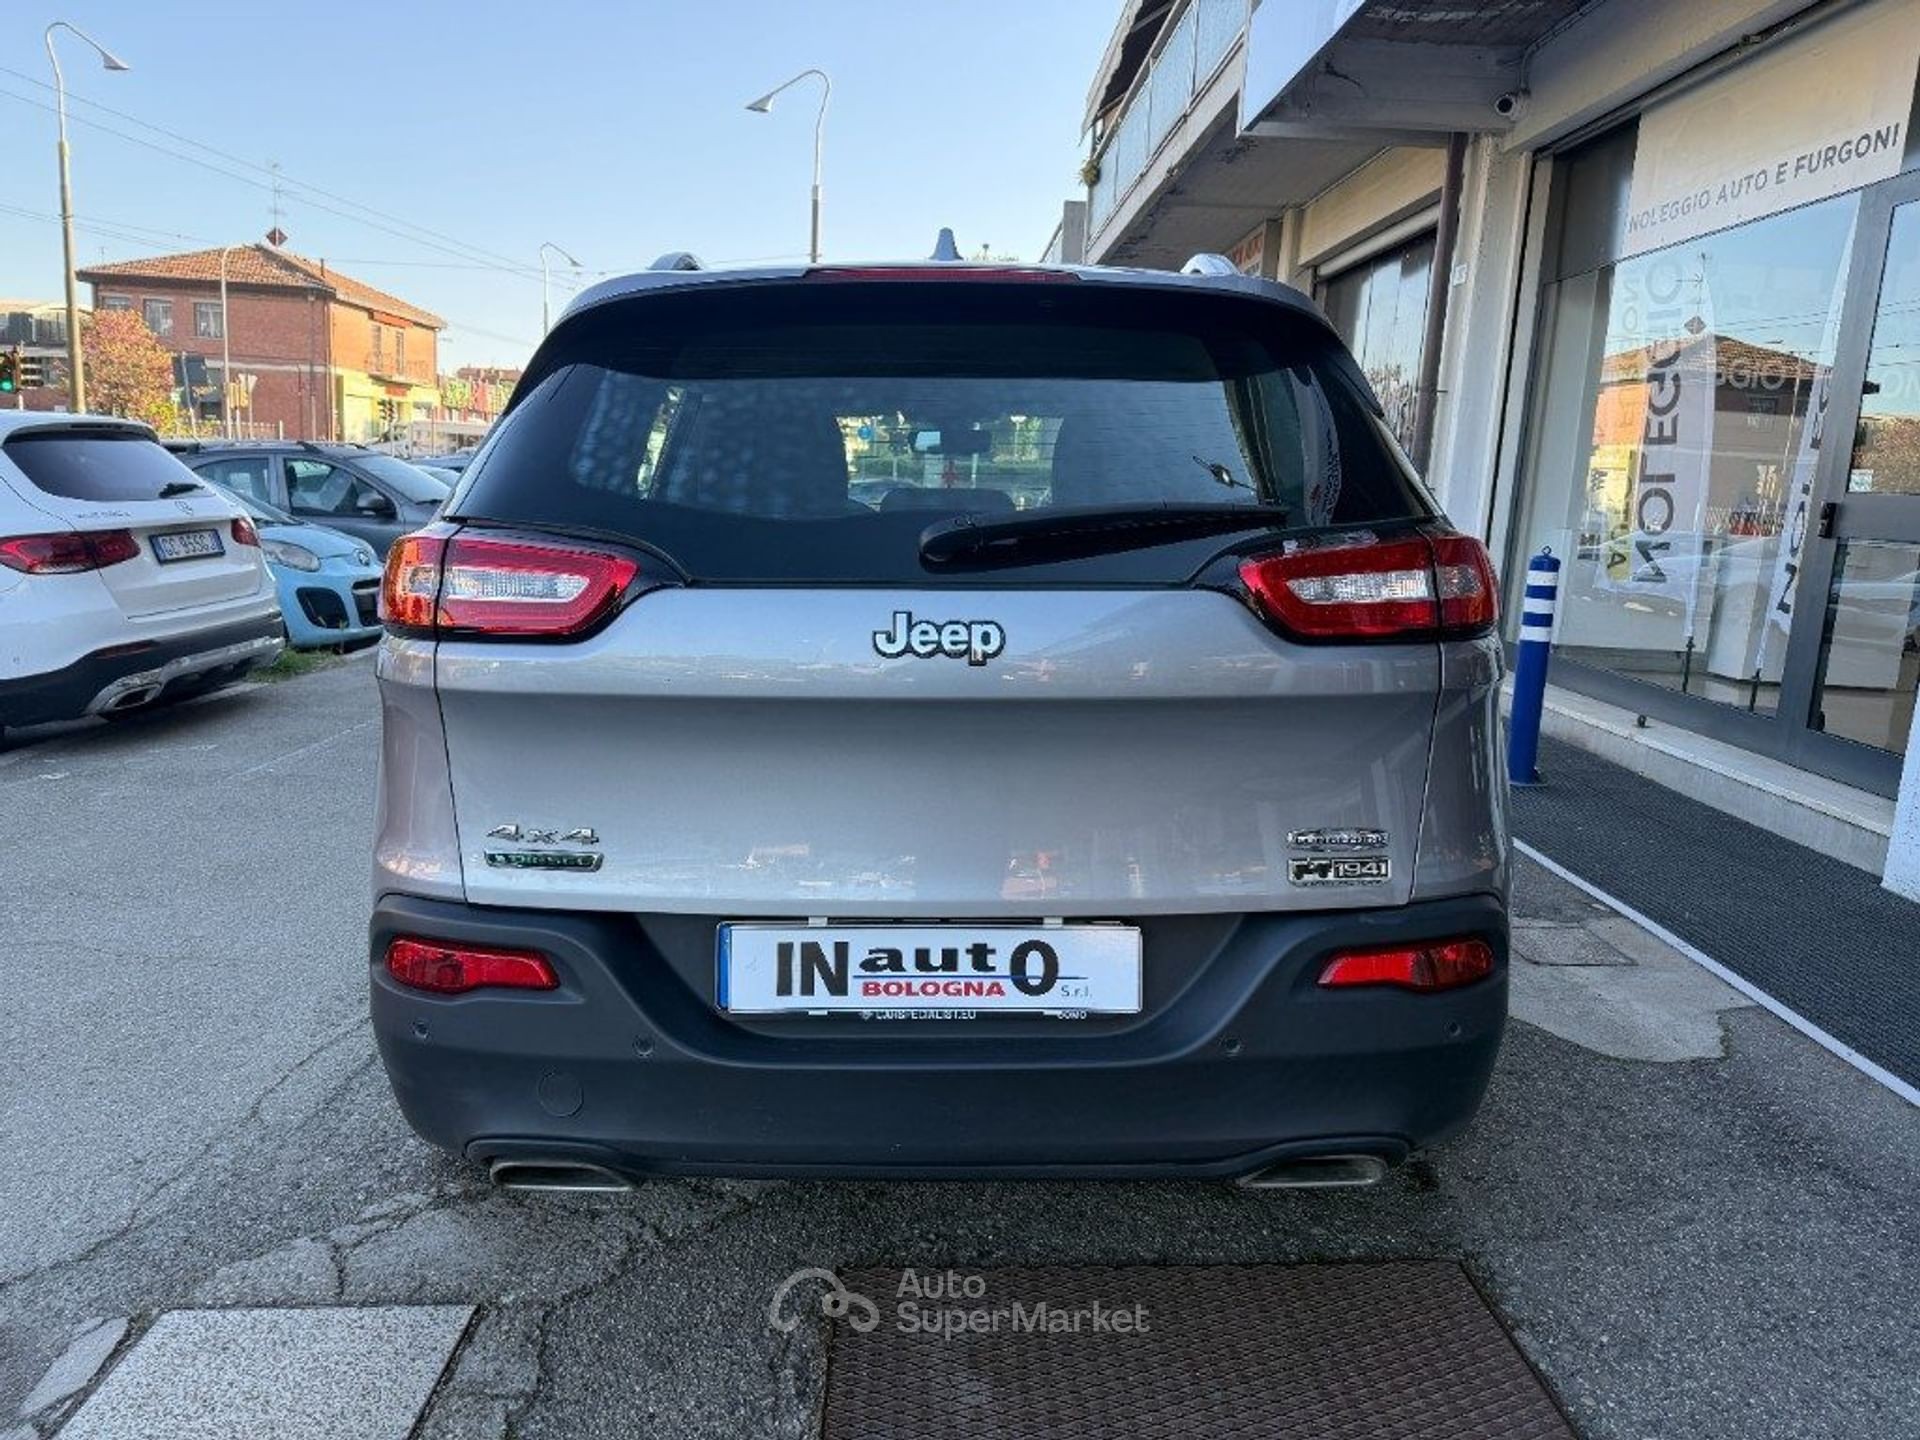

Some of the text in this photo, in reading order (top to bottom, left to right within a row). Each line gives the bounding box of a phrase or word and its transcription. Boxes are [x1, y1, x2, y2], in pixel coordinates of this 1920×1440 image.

[1627, 122, 1900, 233] NOLEGGIO AUTO E FURGONI
[872, 610, 1006, 667] Jeep
[487, 823, 600, 846] 4x4
[1334, 861, 1388, 879] 1941
[862, 981, 1006, 998] BOLOGNA
